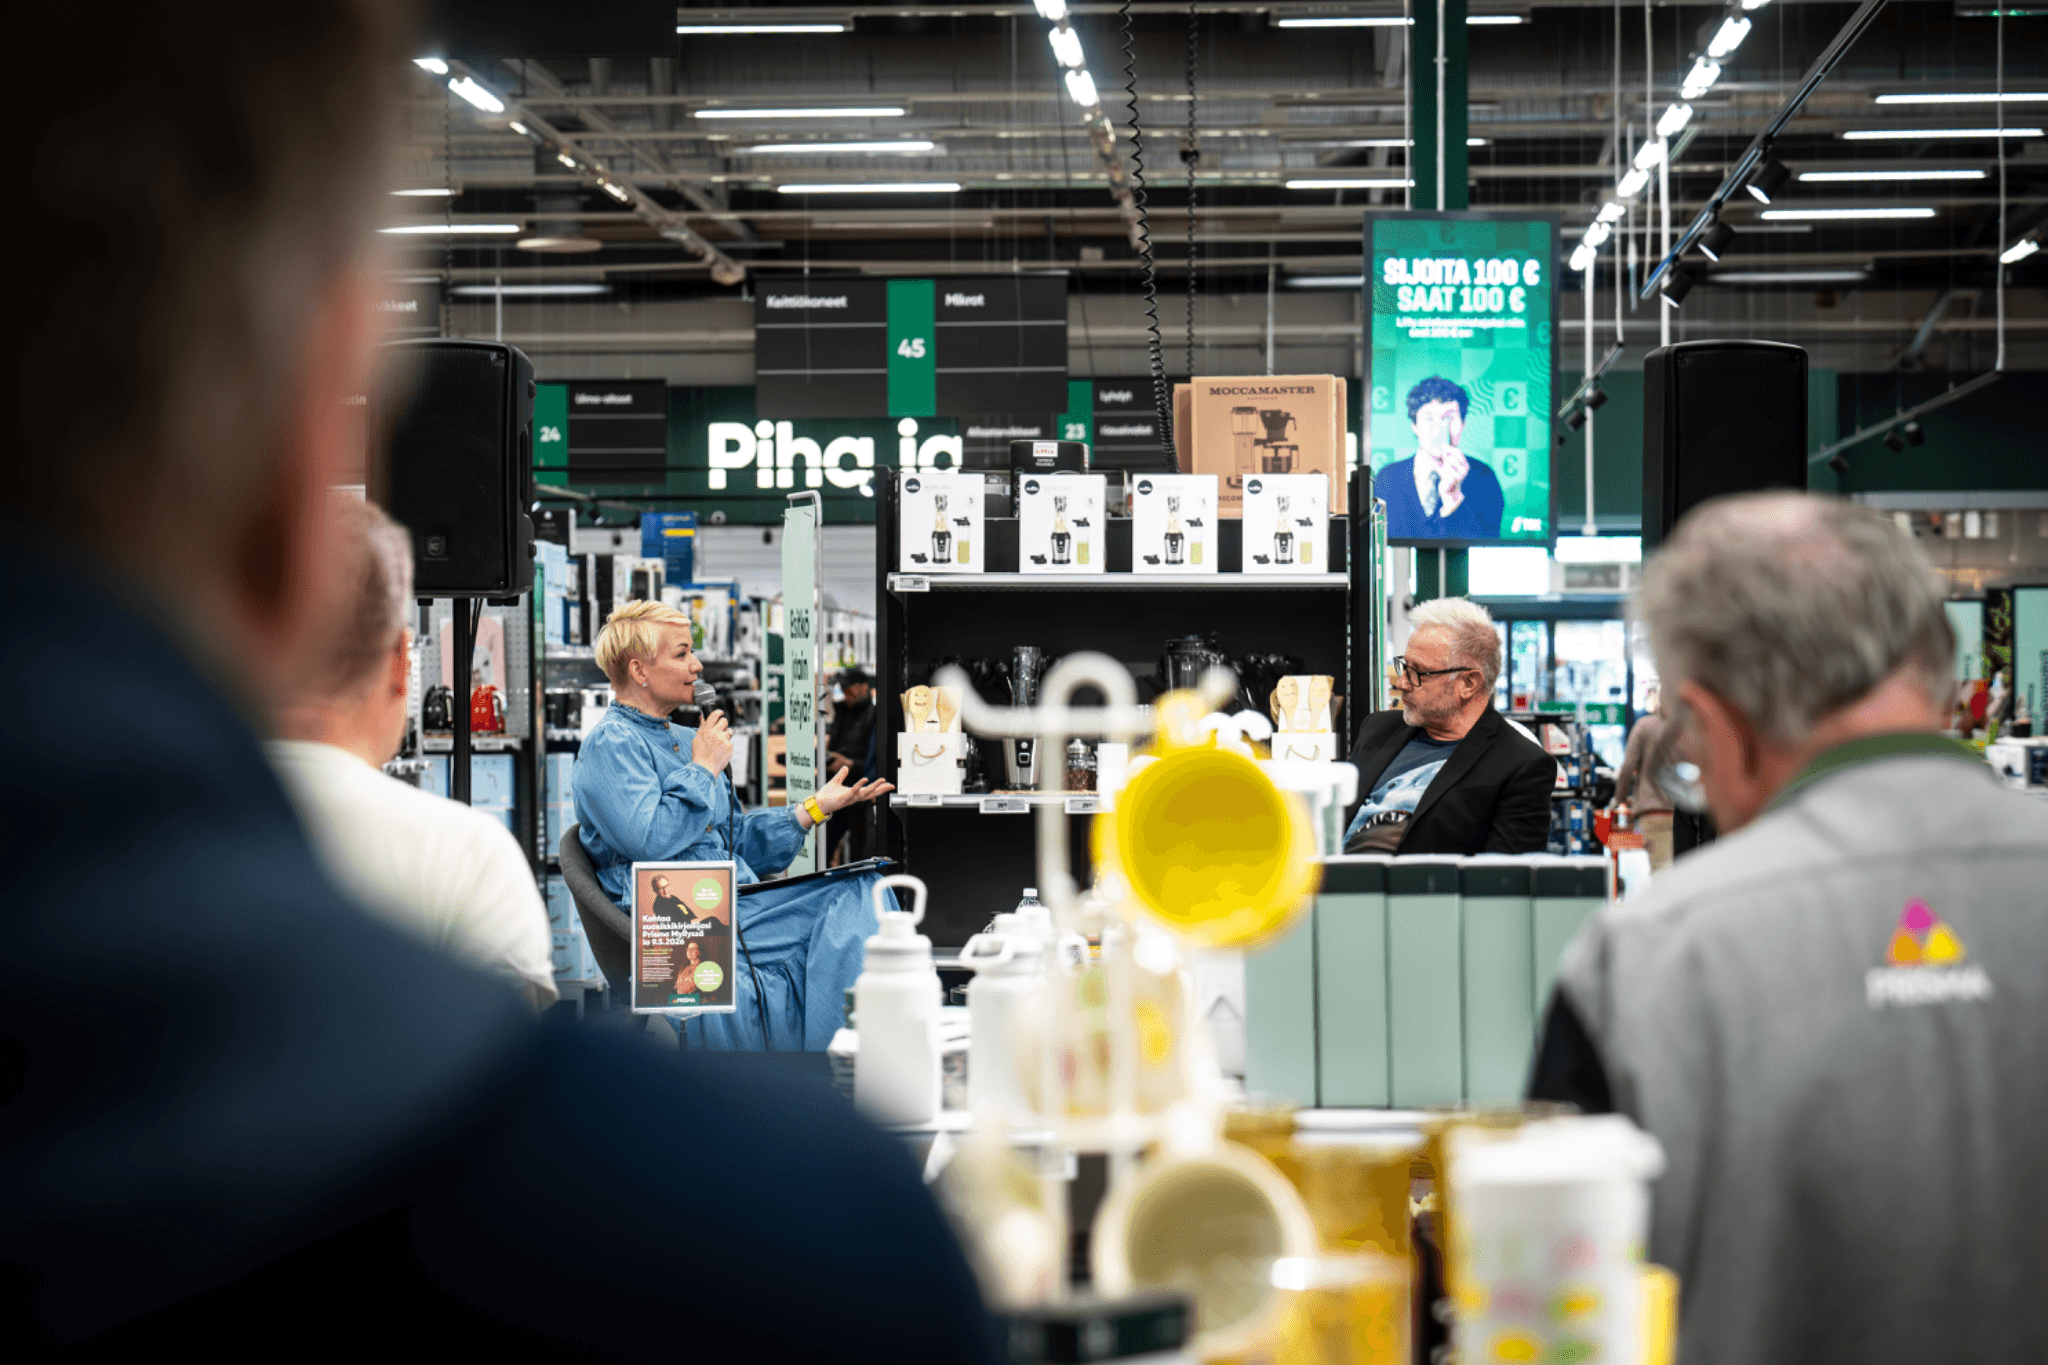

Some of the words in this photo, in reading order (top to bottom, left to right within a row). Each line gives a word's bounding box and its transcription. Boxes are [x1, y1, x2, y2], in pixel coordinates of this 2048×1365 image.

[1383, 257, 1471, 286] SIJOITA
[1473, 258, 1519, 286] 100
[1522, 258, 1541, 286] €
[944, 293, 985, 307] Mikrot
[1397, 286, 1456, 313] SAAT
[1459, 286, 1505, 313] 100
[1508, 286, 1526, 313] €
[897, 338, 926, 358] 45
[1209, 386, 1315, 396] MOCCAMASTER
[539, 425, 561, 442] 24
[708, 419, 875, 489] Piha
[642, 930, 670, 938] Prisma
[652, 938, 685, 946] 9.5.2026
